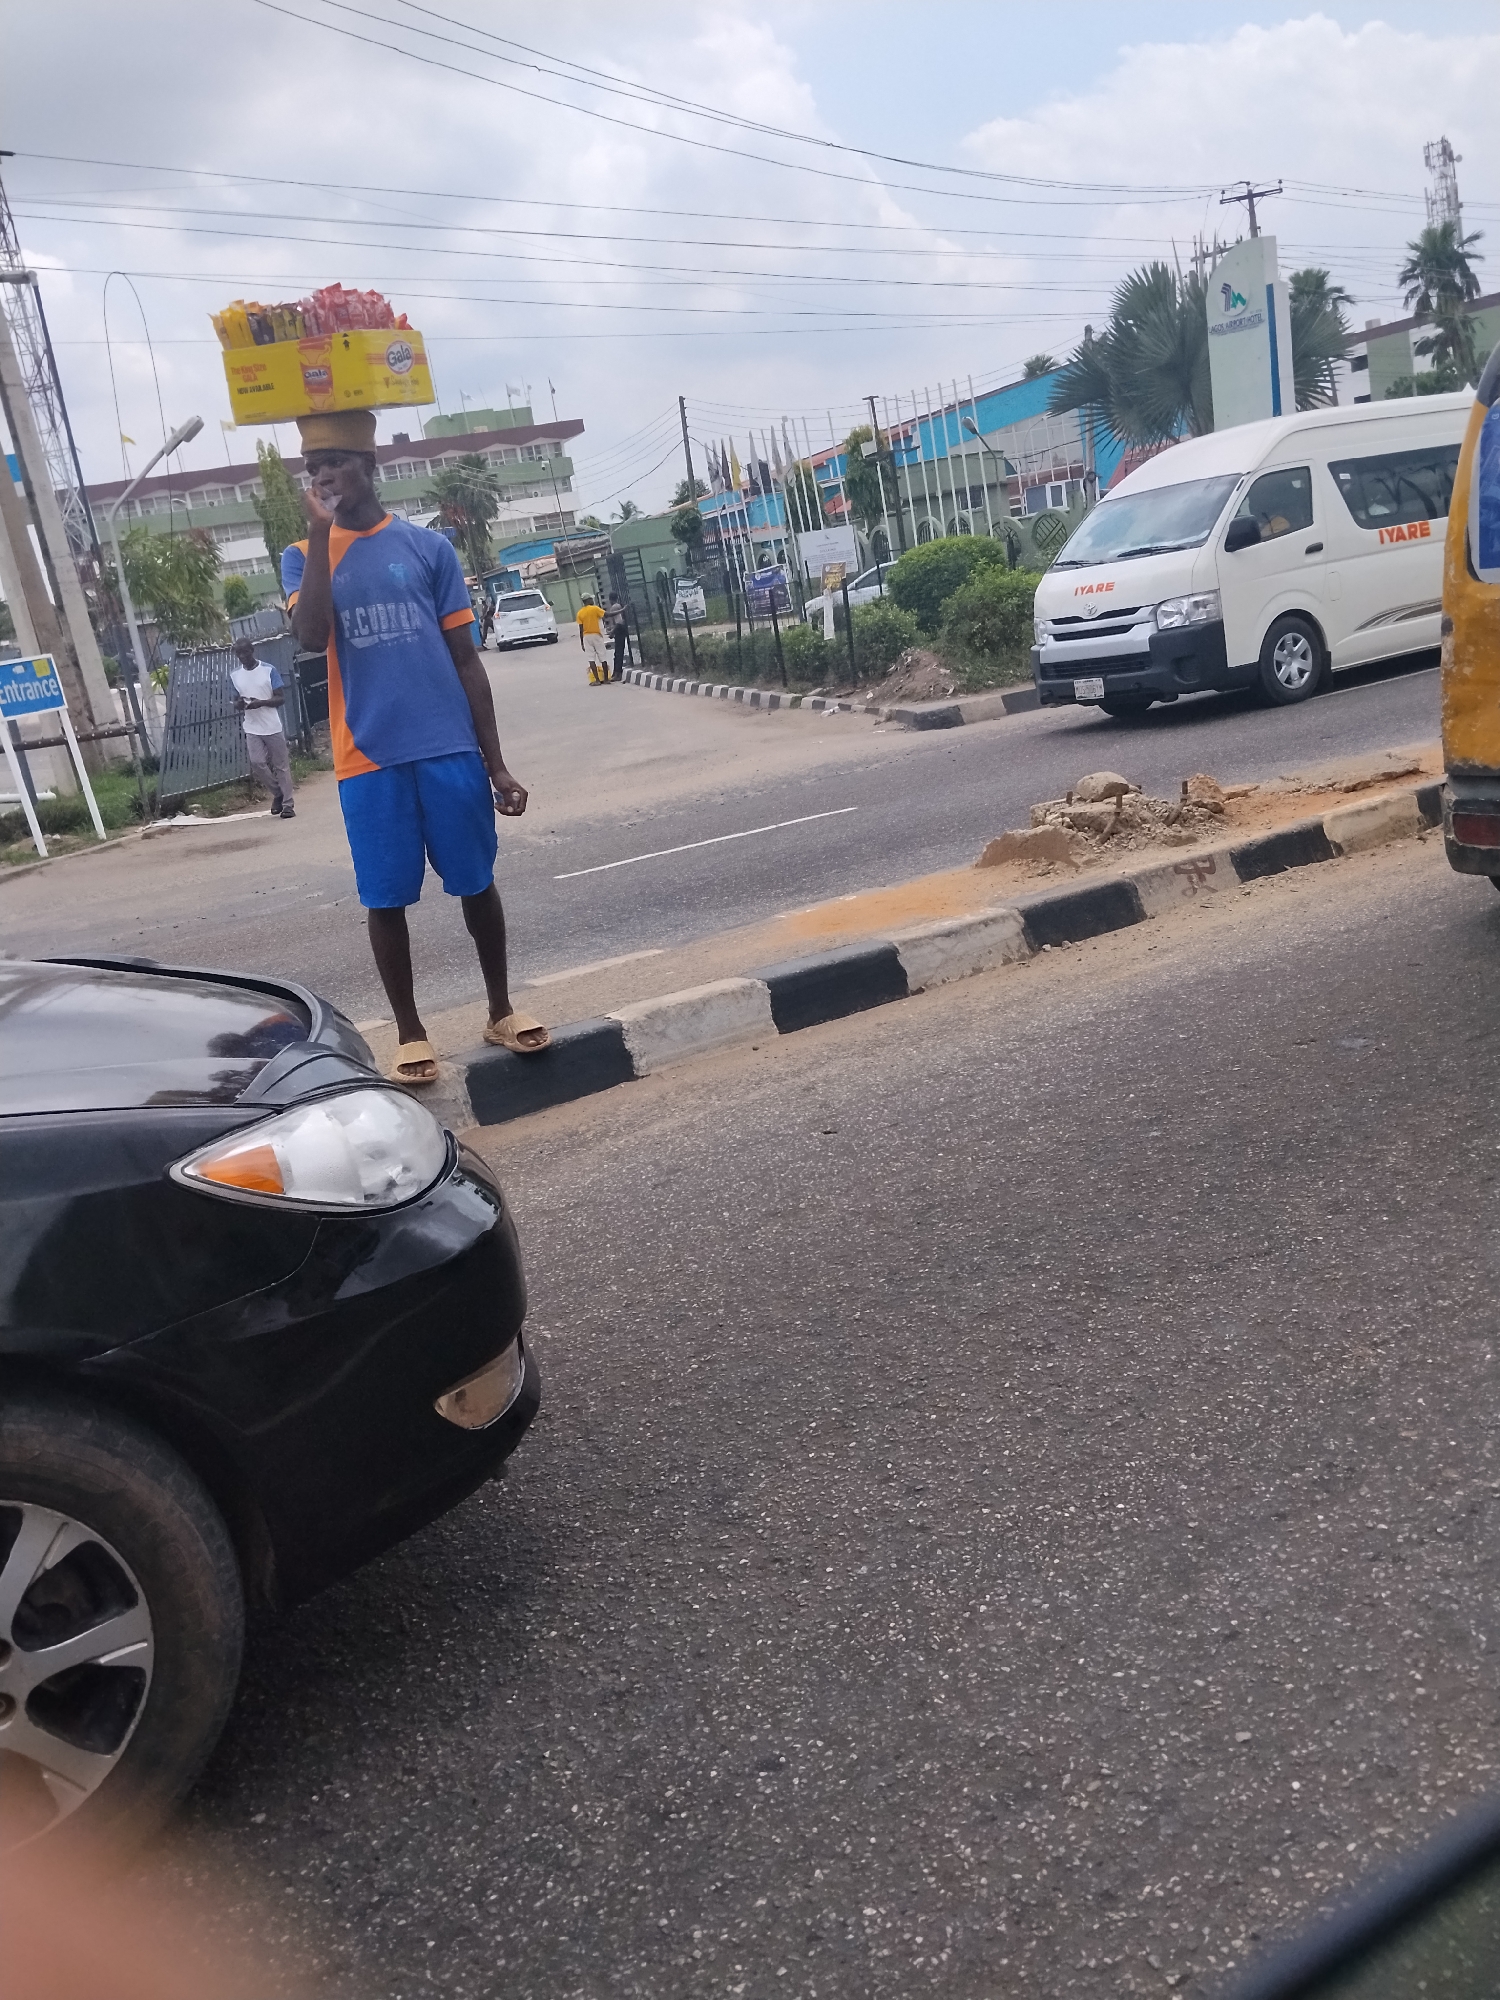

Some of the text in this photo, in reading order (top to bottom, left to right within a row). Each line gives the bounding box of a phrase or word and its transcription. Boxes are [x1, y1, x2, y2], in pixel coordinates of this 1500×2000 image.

[1225, 317, 1245, 329] AIRPORT
[1247, 313, 1262, 323] HOTEL
[387, 345, 411, 367] Gala
[304, 369, 328, 379] Gala
[1378, 520, 1431, 545] IYARE
[1074, 581, 1115, 597] IYARE
